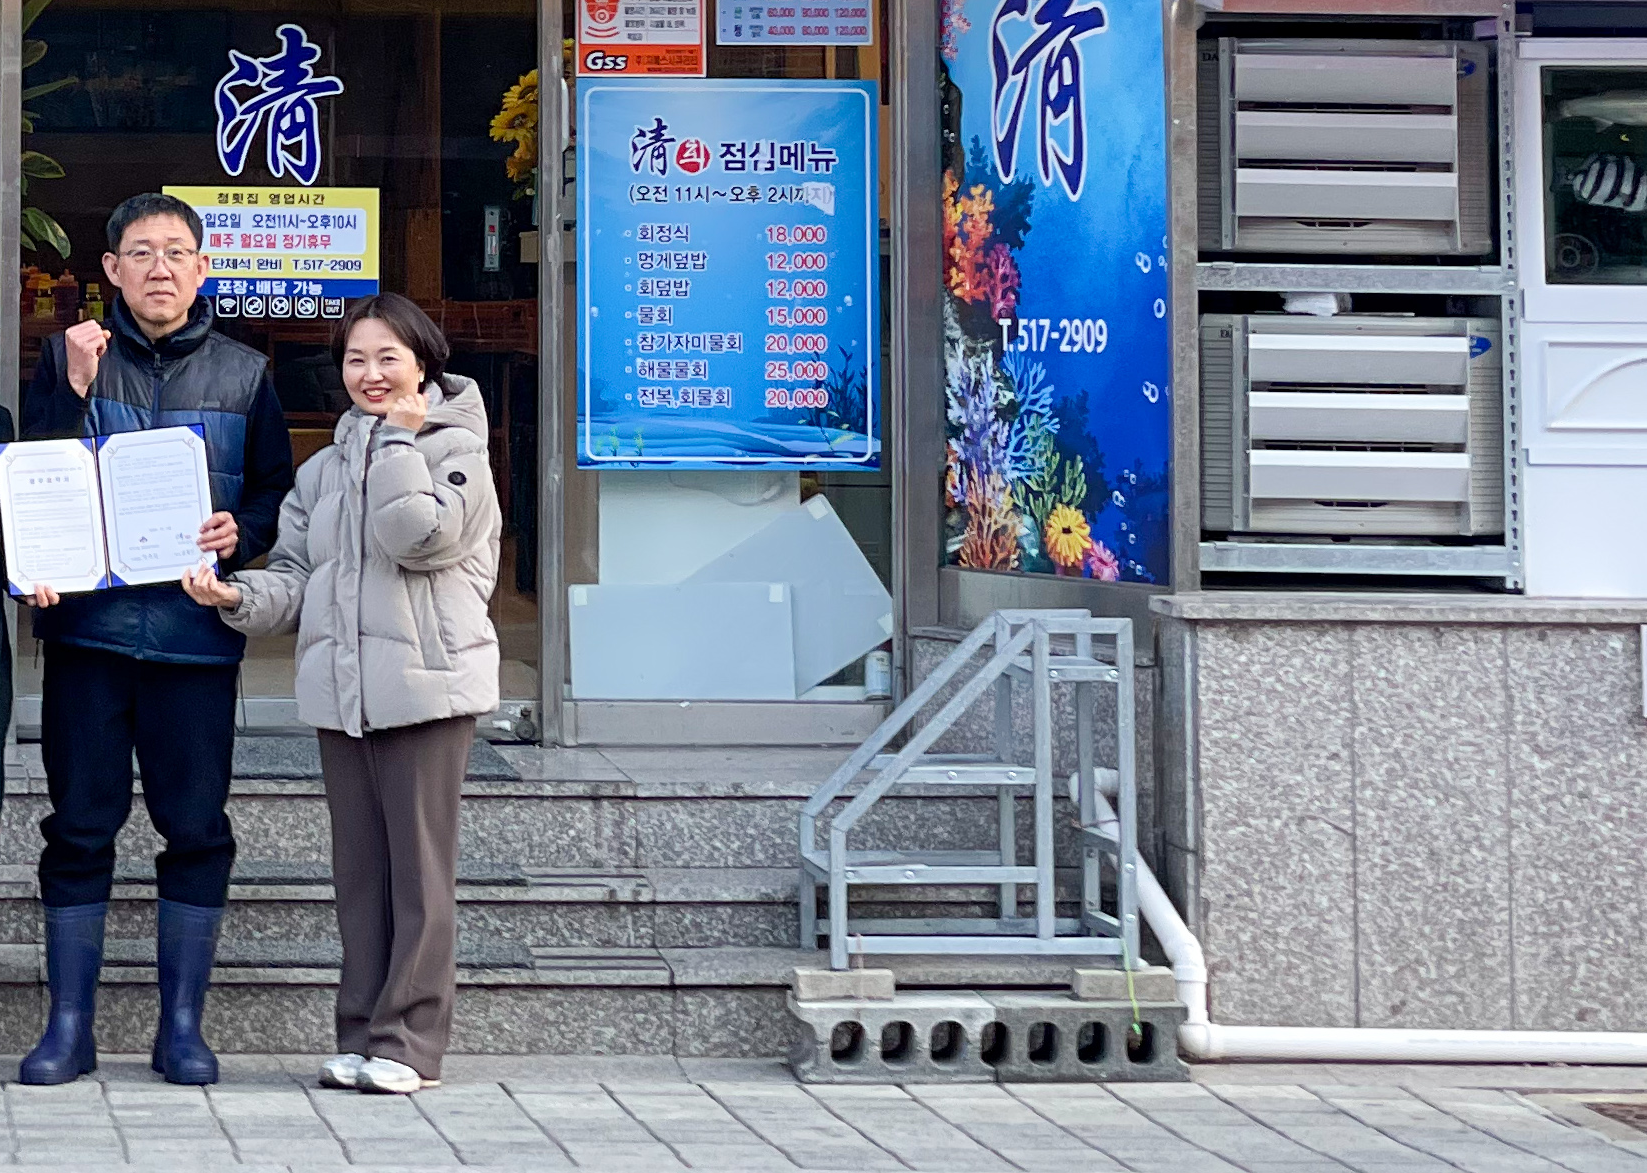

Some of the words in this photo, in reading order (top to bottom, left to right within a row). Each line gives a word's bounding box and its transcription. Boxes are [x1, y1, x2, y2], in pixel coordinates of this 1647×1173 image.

[585, 49, 629, 71] Gss
[719, 141, 837, 172] 점심메뉴
[269, 193, 325, 205] 영업시간
[629, 184, 669, 203] (오전
[202, 213, 241, 228] 일요일
[210, 233, 234, 248] 매주
[241, 233, 276, 248] 월요일
[283, 234, 331, 249] 정기휴무
[638, 224, 690, 243] 회정식
[766, 226, 826, 243] 18,000
[212, 258, 251, 270] 단체석
[257, 258, 282, 270] 완비
[292, 259, 361, 271] T.517-2909
[638, 251, 707, 270] 멍게덮밥
[766, 253, 826, 270] 12,000
[293, 281, 323, 295] 가능
[638, 279, 690, 297] 회덮밥
[766, 281, 826, 298] 12,000
[638, 306, 672, 324] 물회
[766, 308, 826, 325] 15,000
[639, 333, 742, 352] 참가자미물회
[766, 335, 826, 352] 20,000
[999, 319, 1108, 352] T.517-2909
[638, 361, 707, 379] 해물물회
[766, 362, 826, 380] 25,000
[766, 390, 827, 407] 20,000
